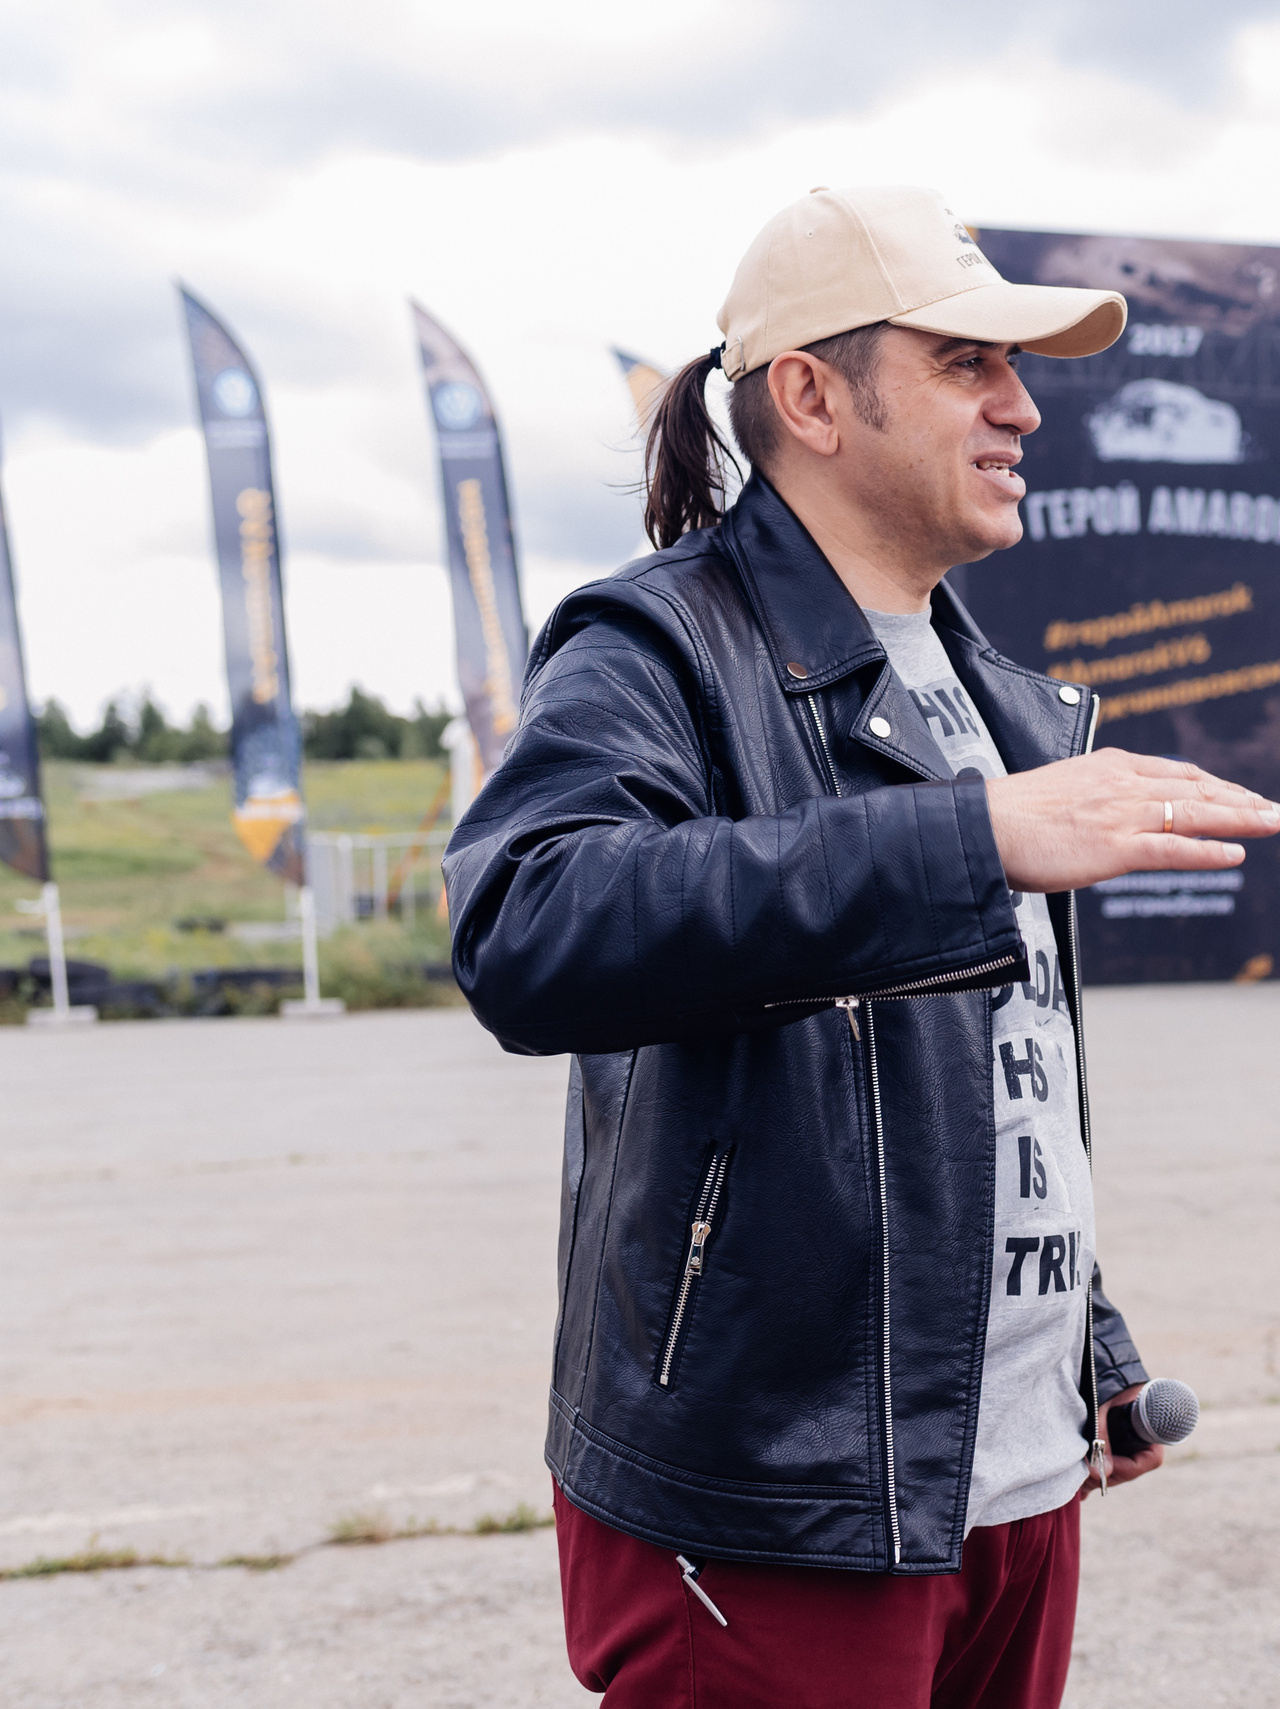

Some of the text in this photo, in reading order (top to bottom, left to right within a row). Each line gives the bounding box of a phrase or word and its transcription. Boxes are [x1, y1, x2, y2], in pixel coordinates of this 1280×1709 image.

[1127, 323, 1203, 357] 2017
[1025, 481, 1141, 542] ГЕРОЙ
[1018, 1136, 1047, 1199] IS
